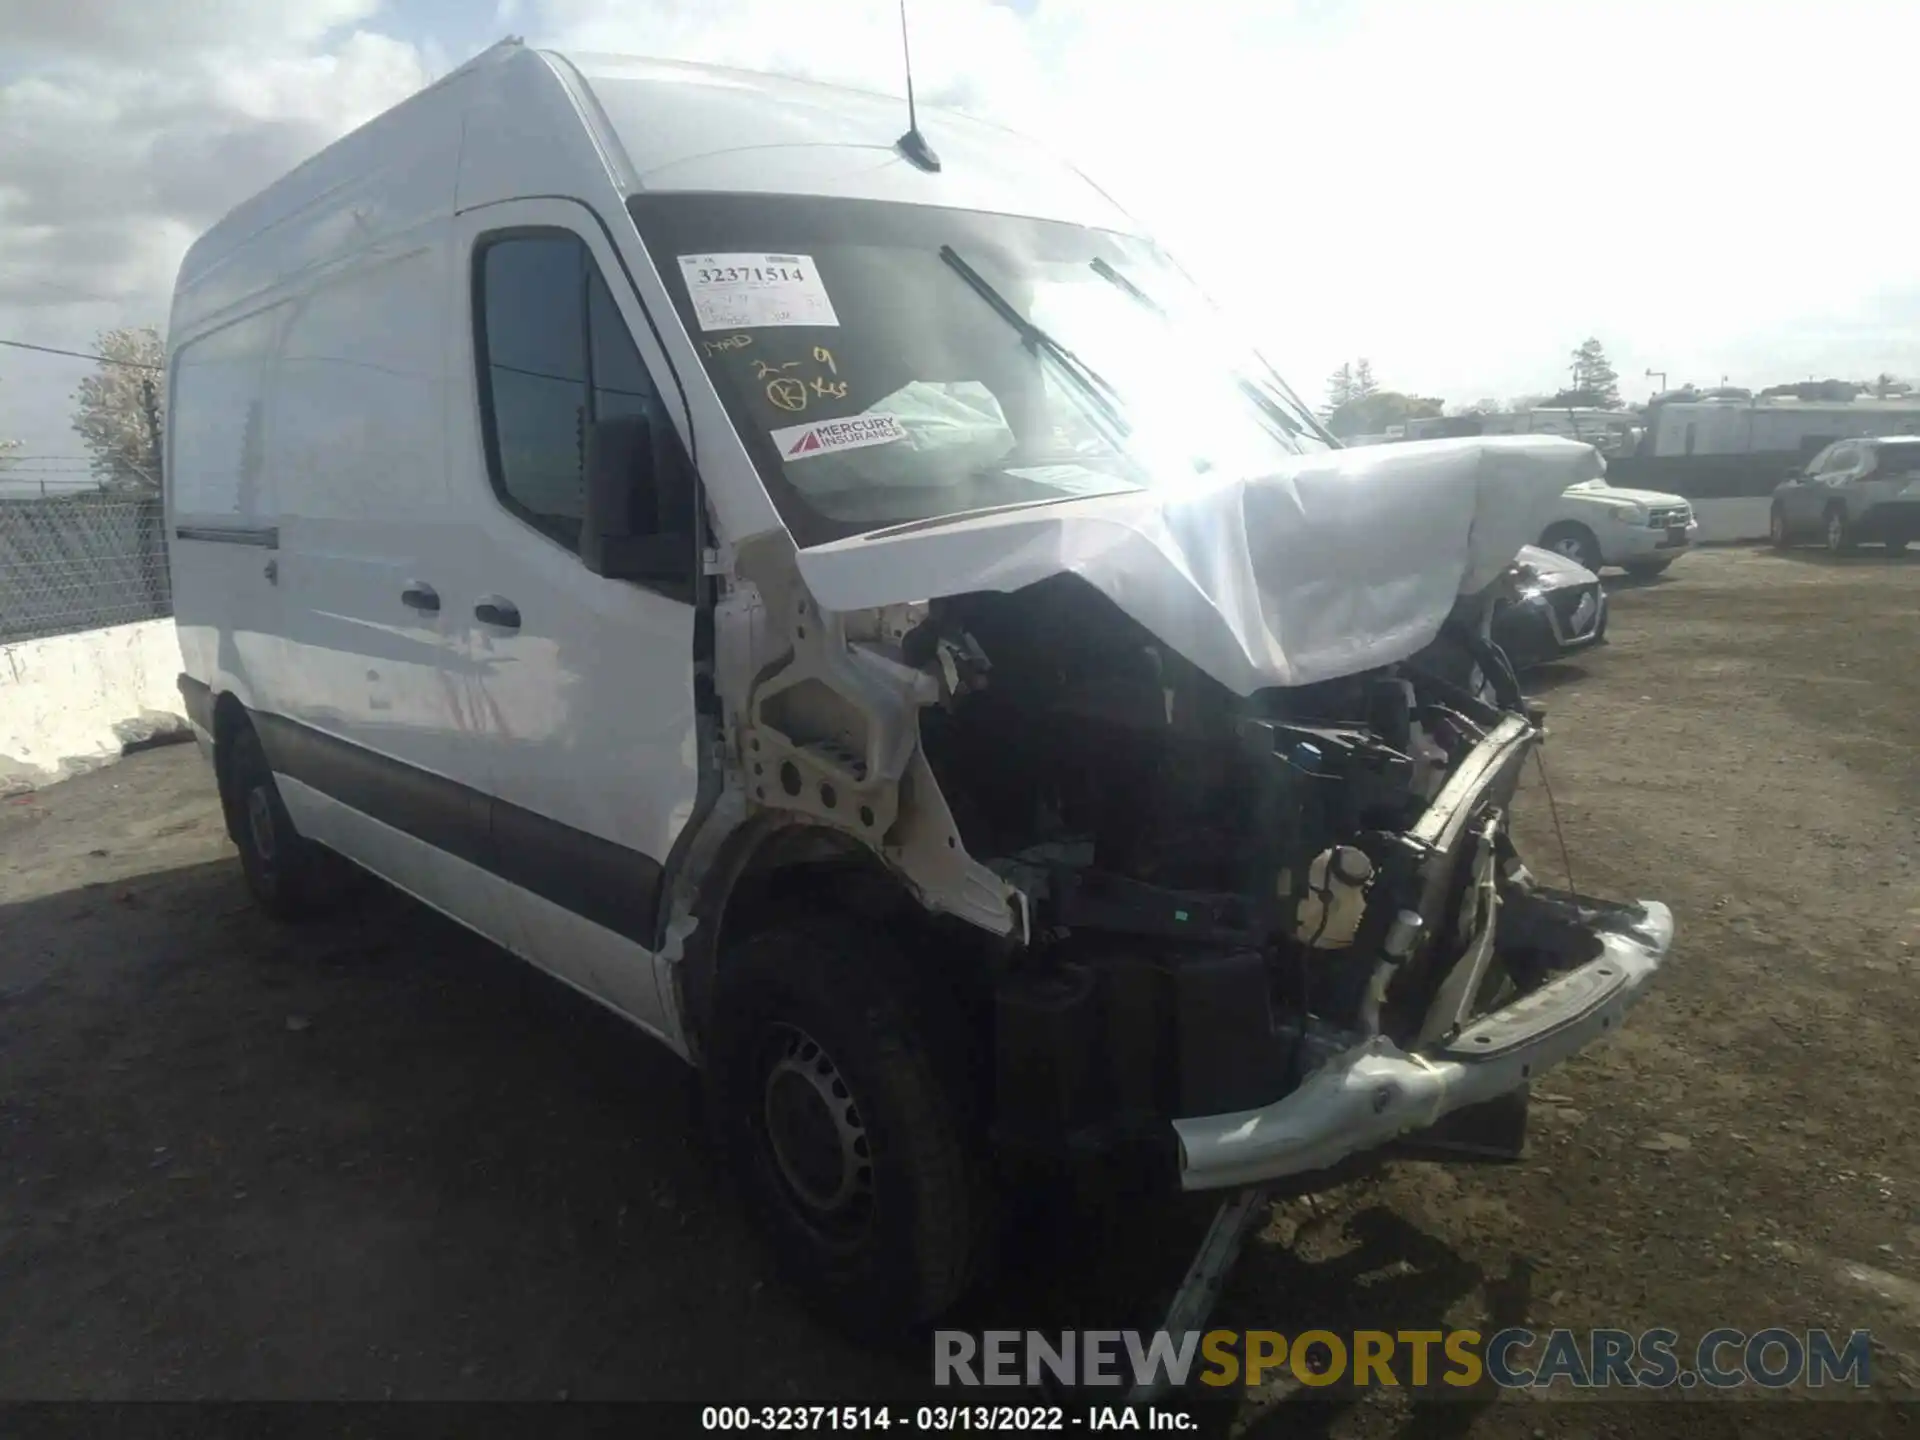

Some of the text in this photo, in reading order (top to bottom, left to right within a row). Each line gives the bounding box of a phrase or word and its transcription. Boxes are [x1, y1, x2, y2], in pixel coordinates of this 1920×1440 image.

[698, 266, 804, 284] 32371514
[815, 416, 894, 437] MERCURY
[820, 426, 903, 447] INSURANCE
